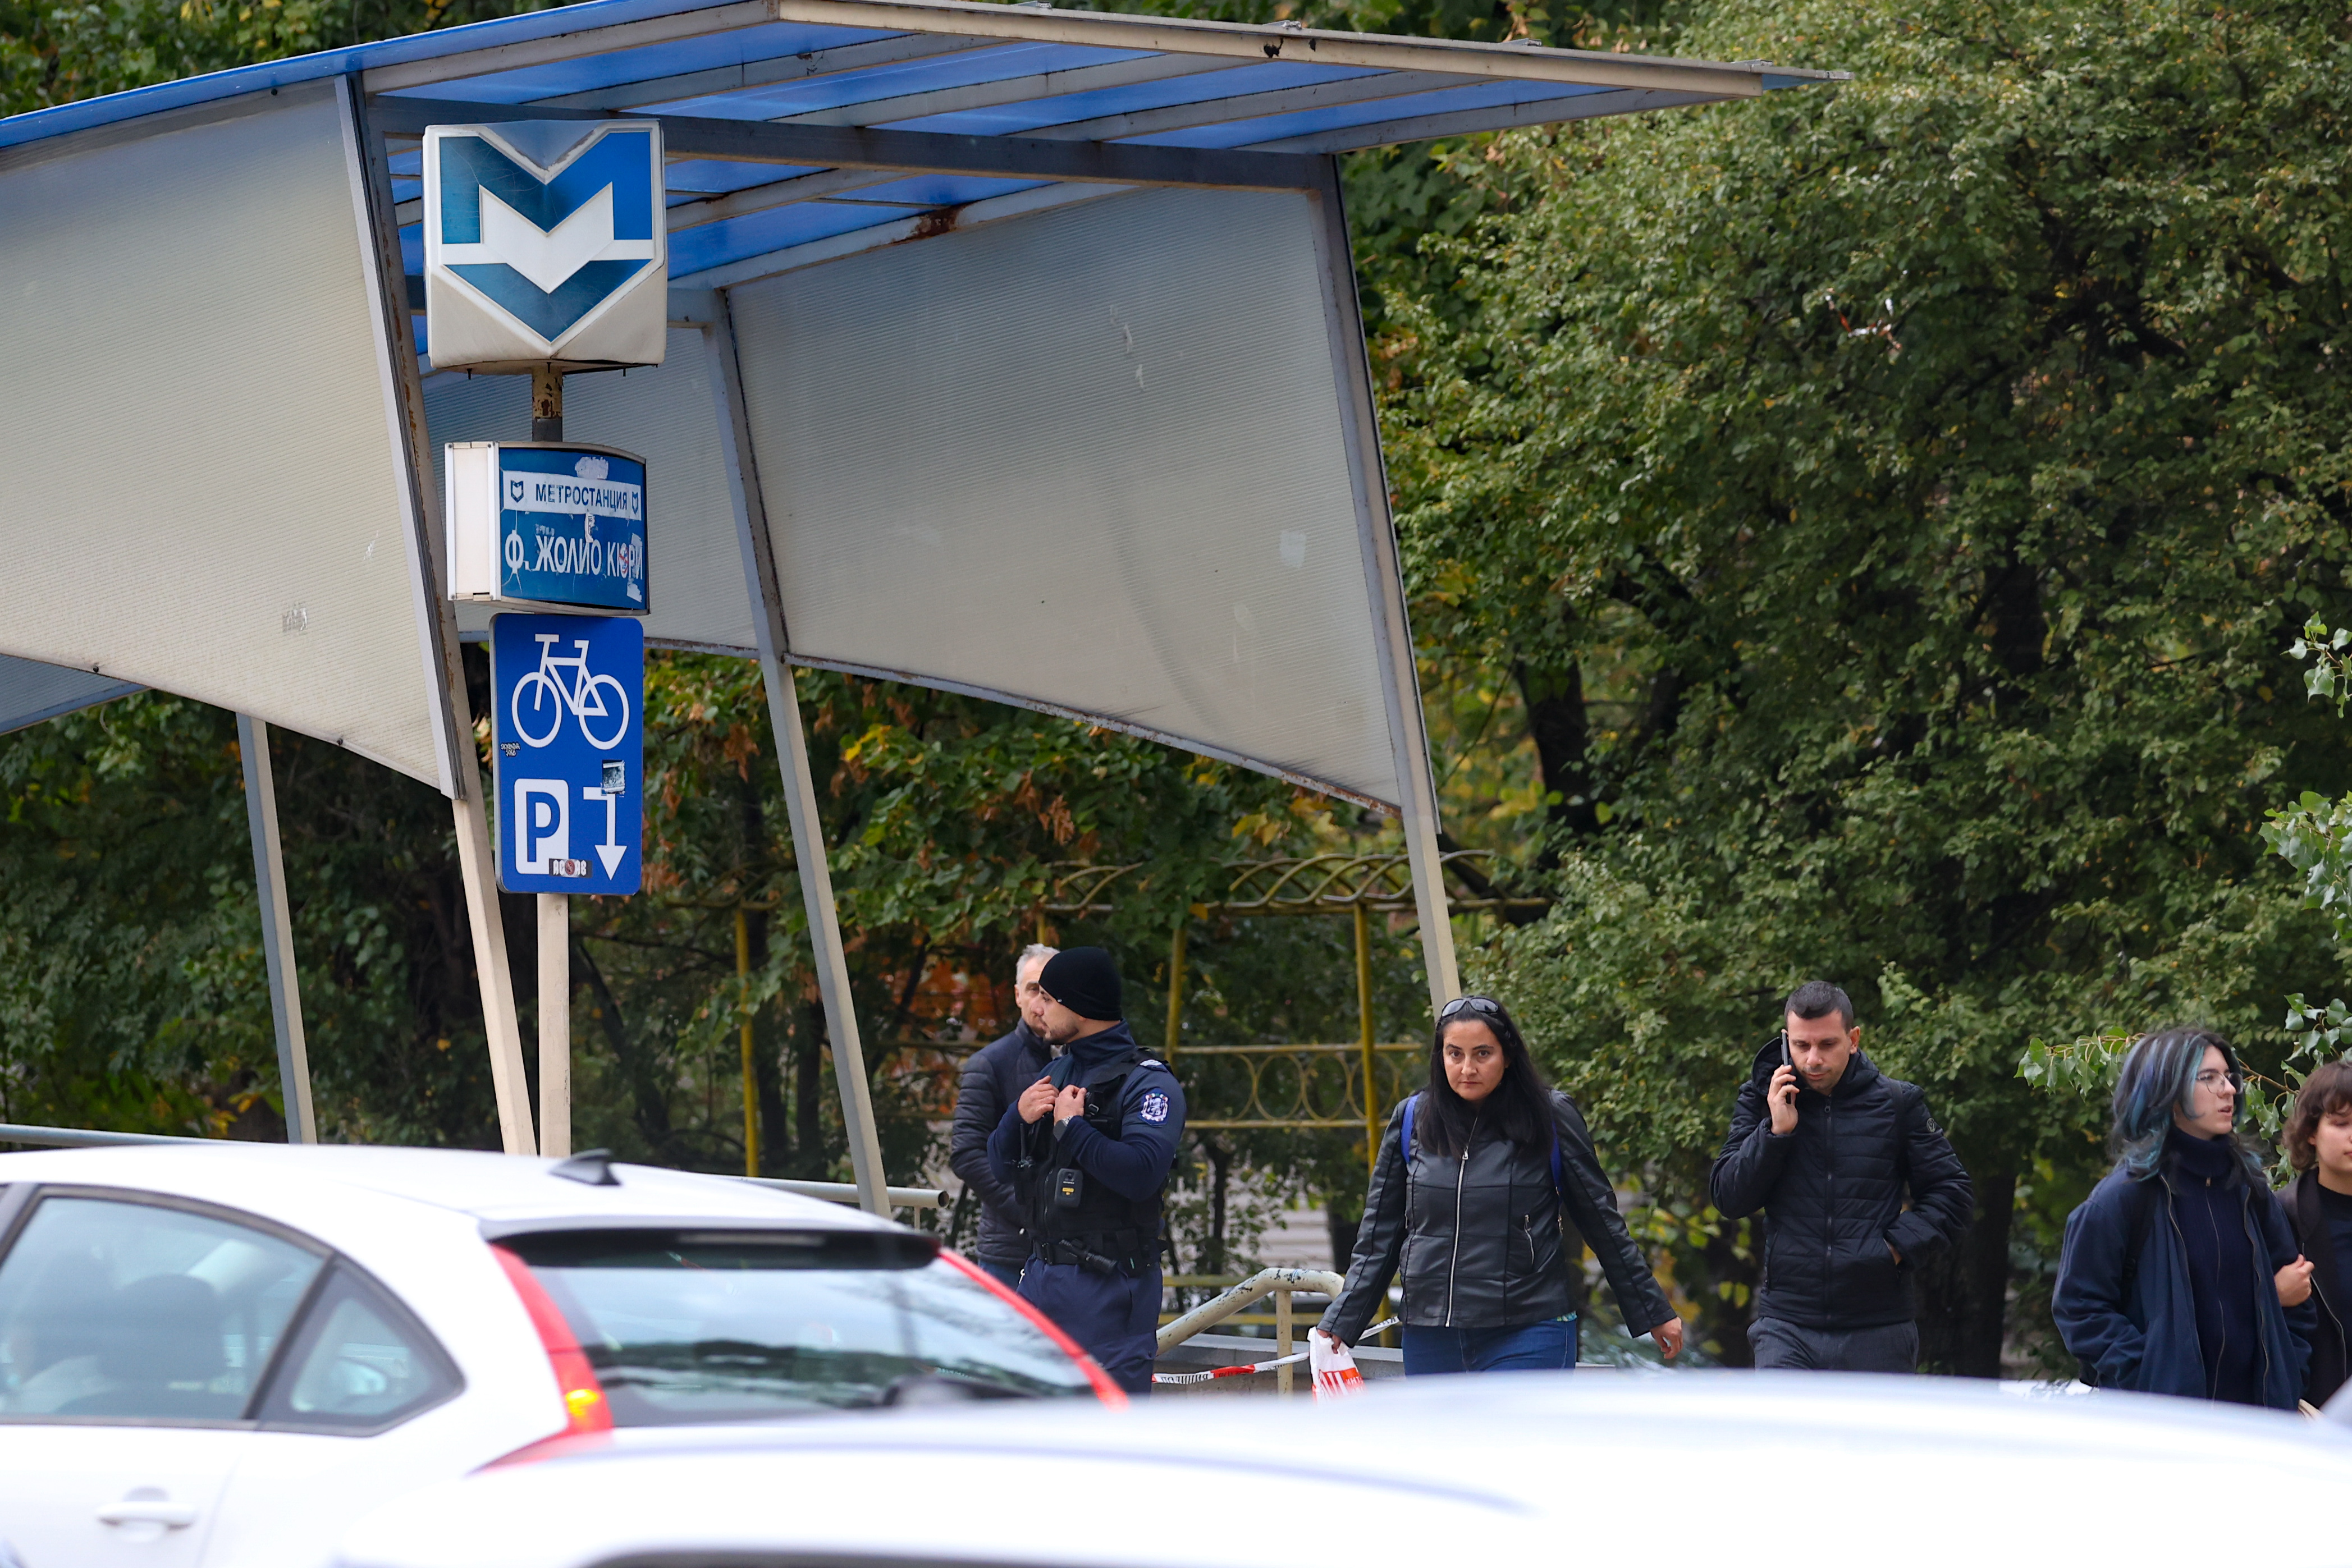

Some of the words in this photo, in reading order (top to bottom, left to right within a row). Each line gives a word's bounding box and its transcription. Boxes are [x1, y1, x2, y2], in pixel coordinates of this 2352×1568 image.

[536, 484, 627, 512] МЕТРОСТАНЦИЯ
[505, 530, 529, 574] Ф.
[536, 535, 602, 575] ЖОЛИО
